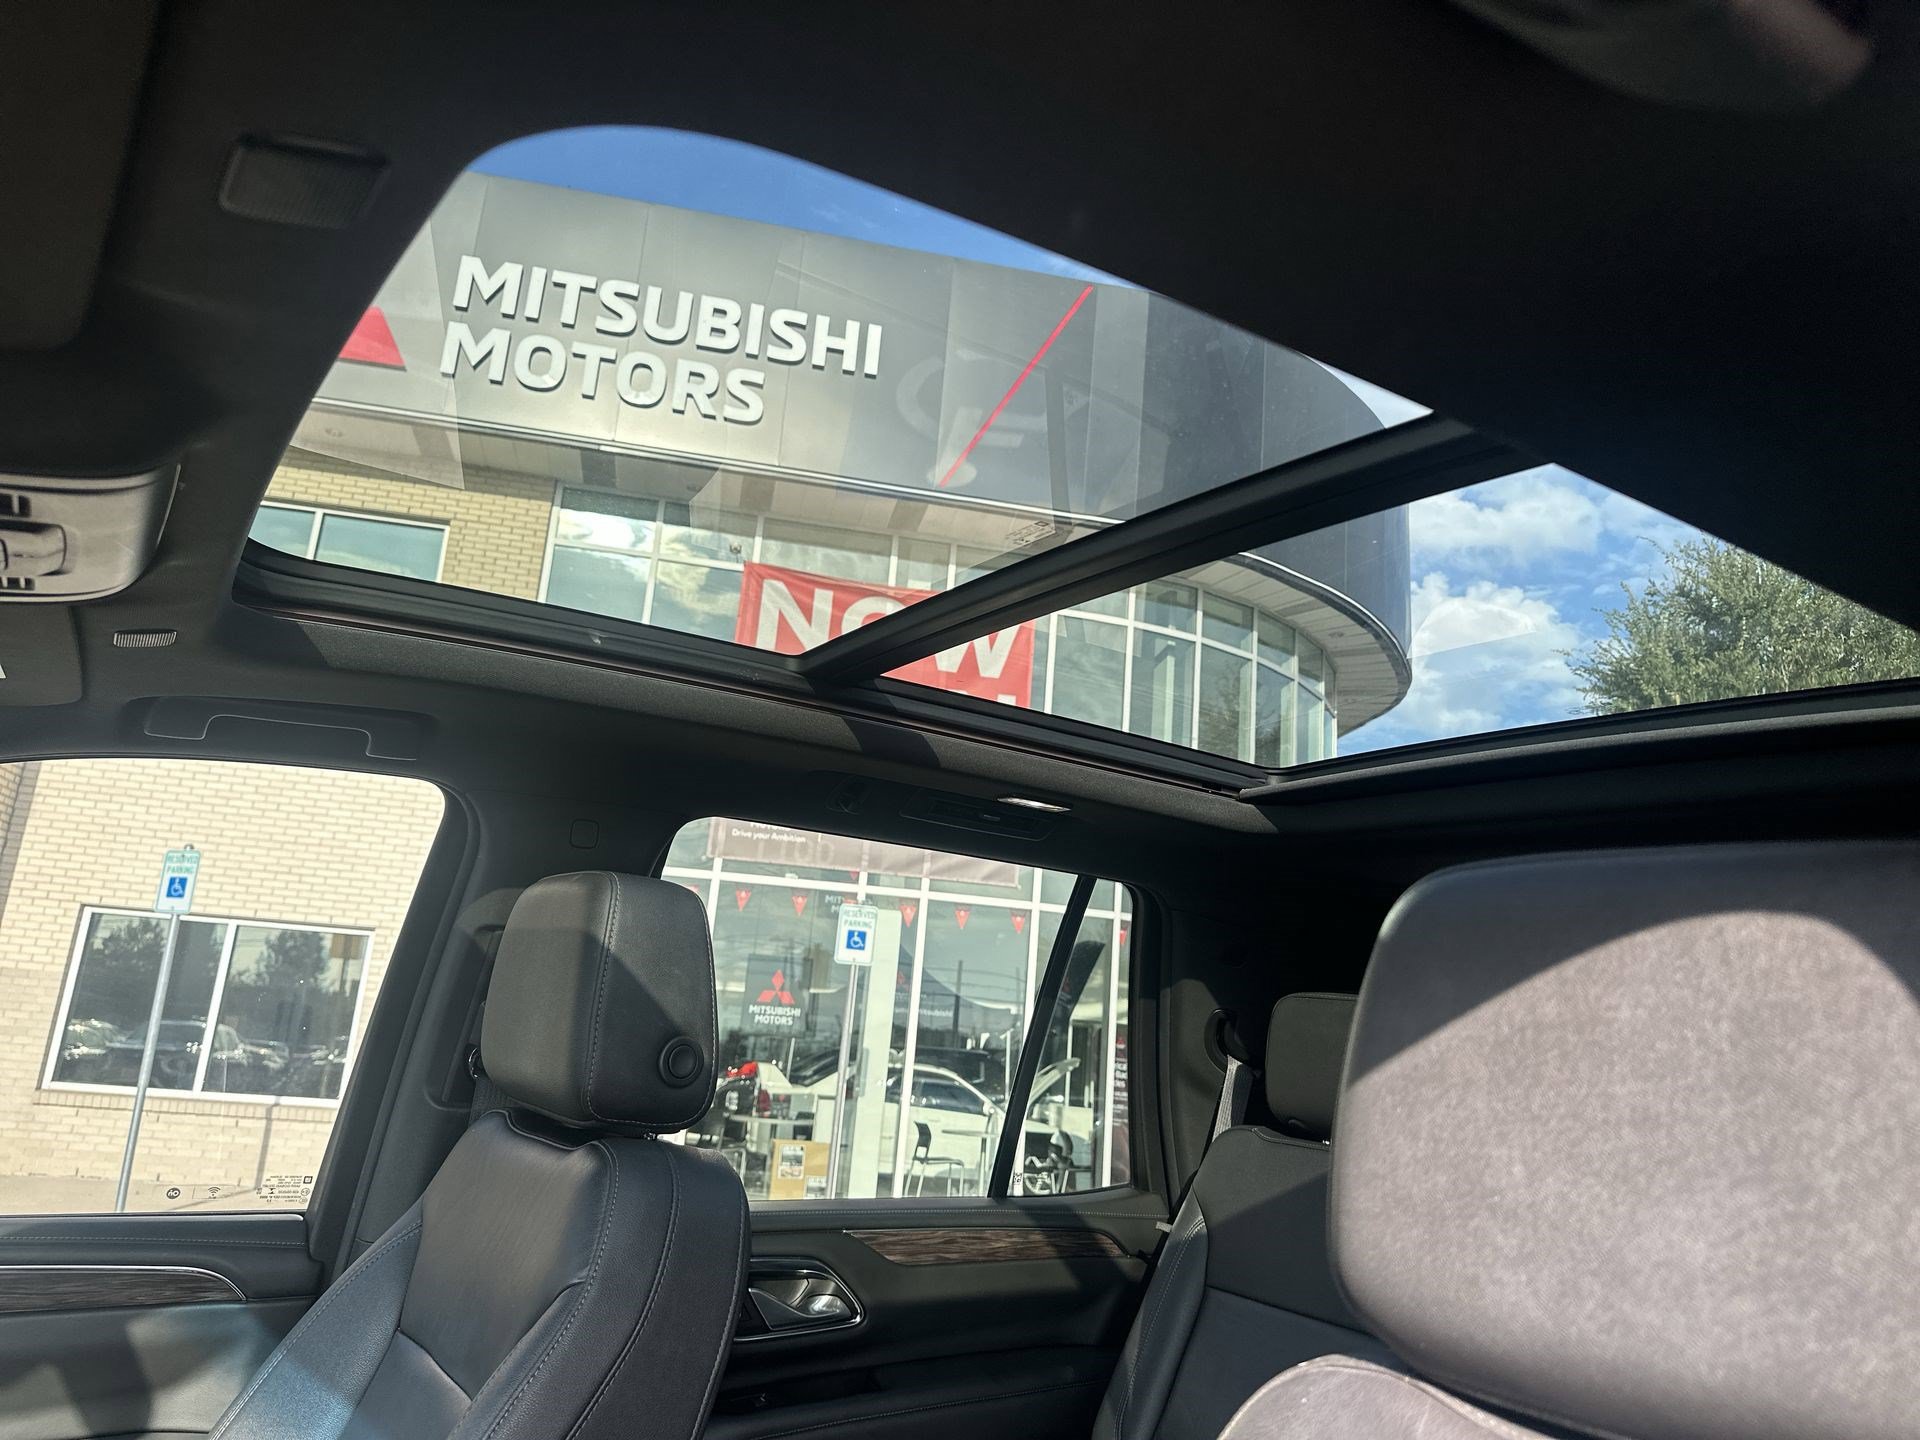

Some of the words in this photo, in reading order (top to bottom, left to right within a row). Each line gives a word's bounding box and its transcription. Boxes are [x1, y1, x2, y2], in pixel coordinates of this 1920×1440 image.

[453, 255, 882, 378] MITSUBISHI
[439, 321, 766, 425] MOTORS
[731, 828, 752, 838] Drive
[752, 832, 770, 841] your
[771, 832, 807, 843] Ambition
[843, 909, 876, 919] RESERVED
[843, 918, 873, 928] PARKING
[748, 1004, 801, 1017] MITSUBISHI
[754, 1014, 794, 1026] MOTORS
